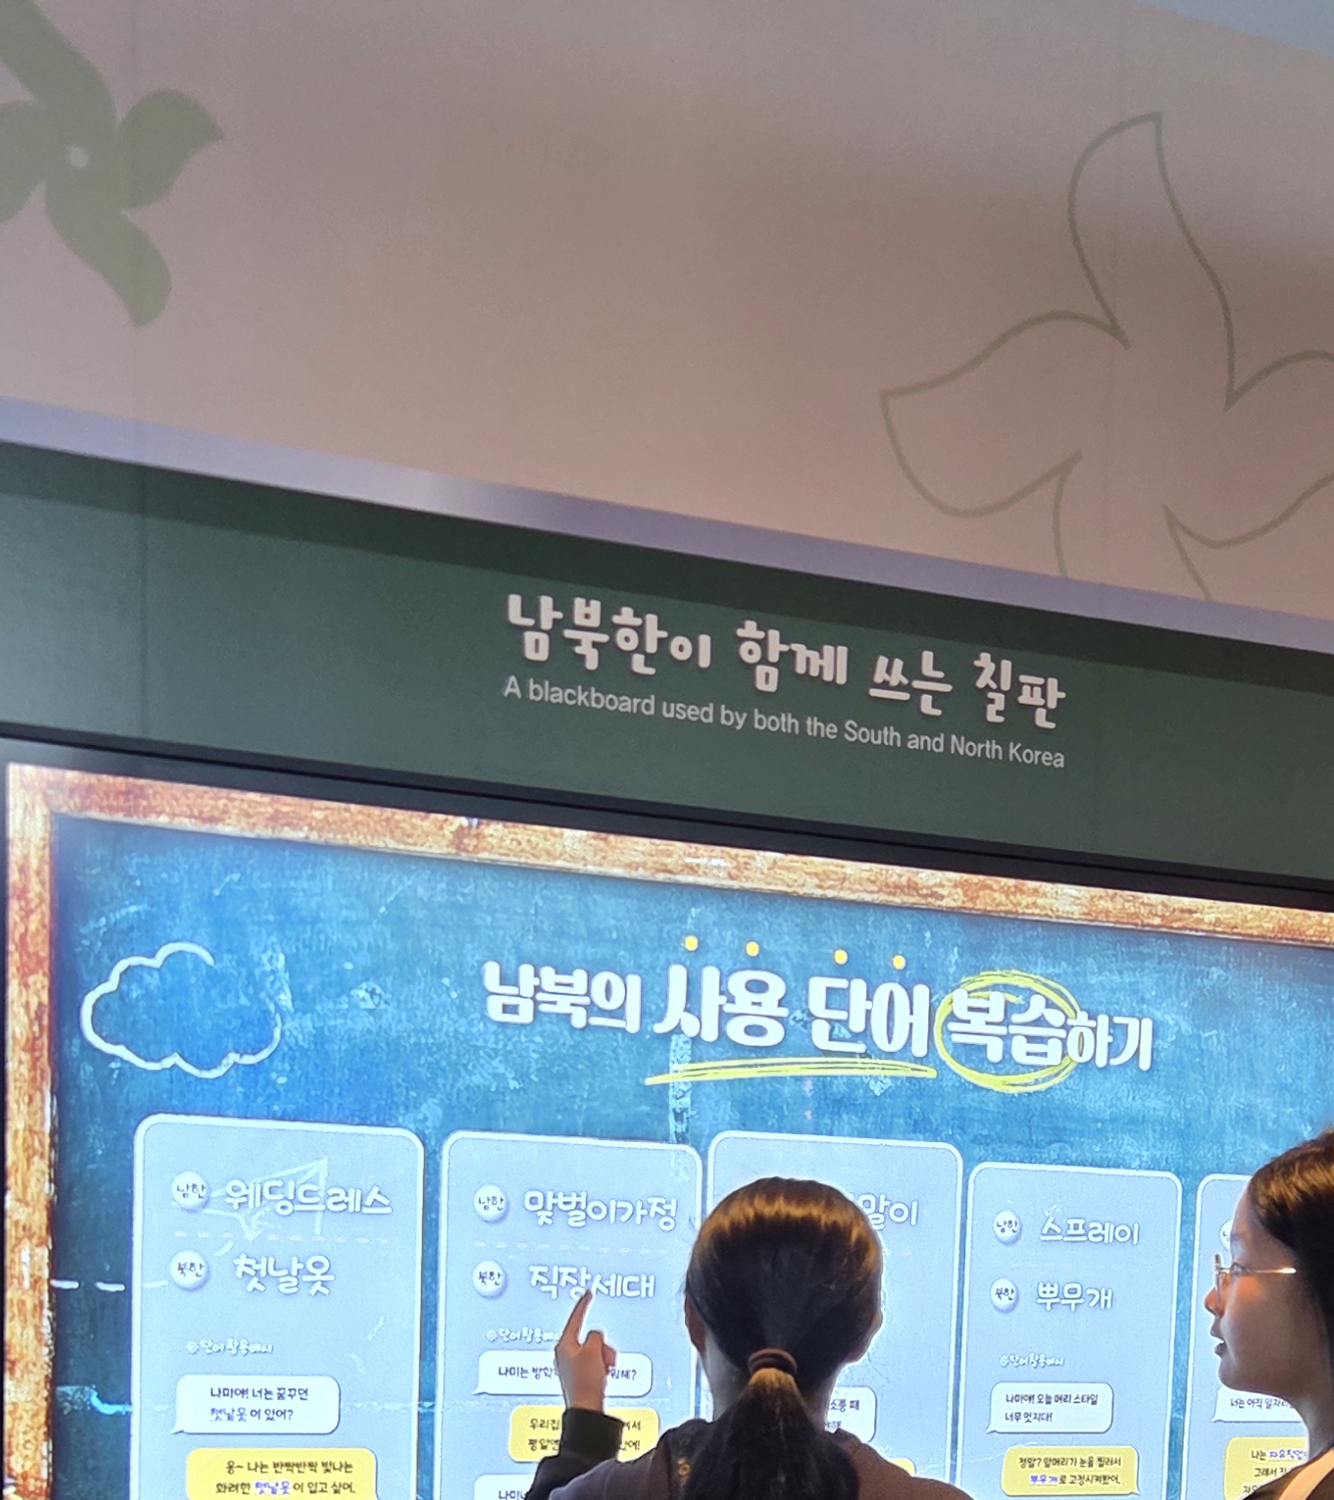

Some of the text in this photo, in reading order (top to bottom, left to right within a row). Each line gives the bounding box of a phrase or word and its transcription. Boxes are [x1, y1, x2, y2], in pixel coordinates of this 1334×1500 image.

[507, 593, 1066, 729] 남북한이 함께 쓰는 칠판
[503, 675, 1066, 769] A blackboard used by both the South and North Korea
[483, 959, 1154, 1072] 남북의 사용 단어 복습하기
[177, 1178, 393, 1217] 남한 웨딩드레스
[479, 1189, 679, 1231] 남한 맞벌이가정
[1039, 1215, 1141, 1246] 스프레이
[233, 1253, 336, 1296] 첫날옷
[528, 1264, 656, 1300] 직장세대
[1036, 1281, 1114, 1312] 뿌무개
[498, 1367, 530, 1378] 나미는
[532, 1367, 559, 1380] 방학
[210, 1387, 309, 1401] 나미야! 너는 꿈꾸던
[1036, 1393, 1052, 1405] 오늘
[1054, 1394, 1072, 1405] 머리
[1073, 1393, 1099, 1406] 스타일
[265, 1408, 294, 1421] 있어?
[1004, 1411, 1053, 1424] 너무 멋지다!
[247, 1461, 268, 1474] 나는
[272, 1461, 318, 1474] 반짝반짝
[321, 1461, 353, 1474] 빛나는
[1079, 1456, 1095, 1468] 눈을
[216, 1482, 251, 1495] 화려한
[307, 1482, 328, 1494] 입고
